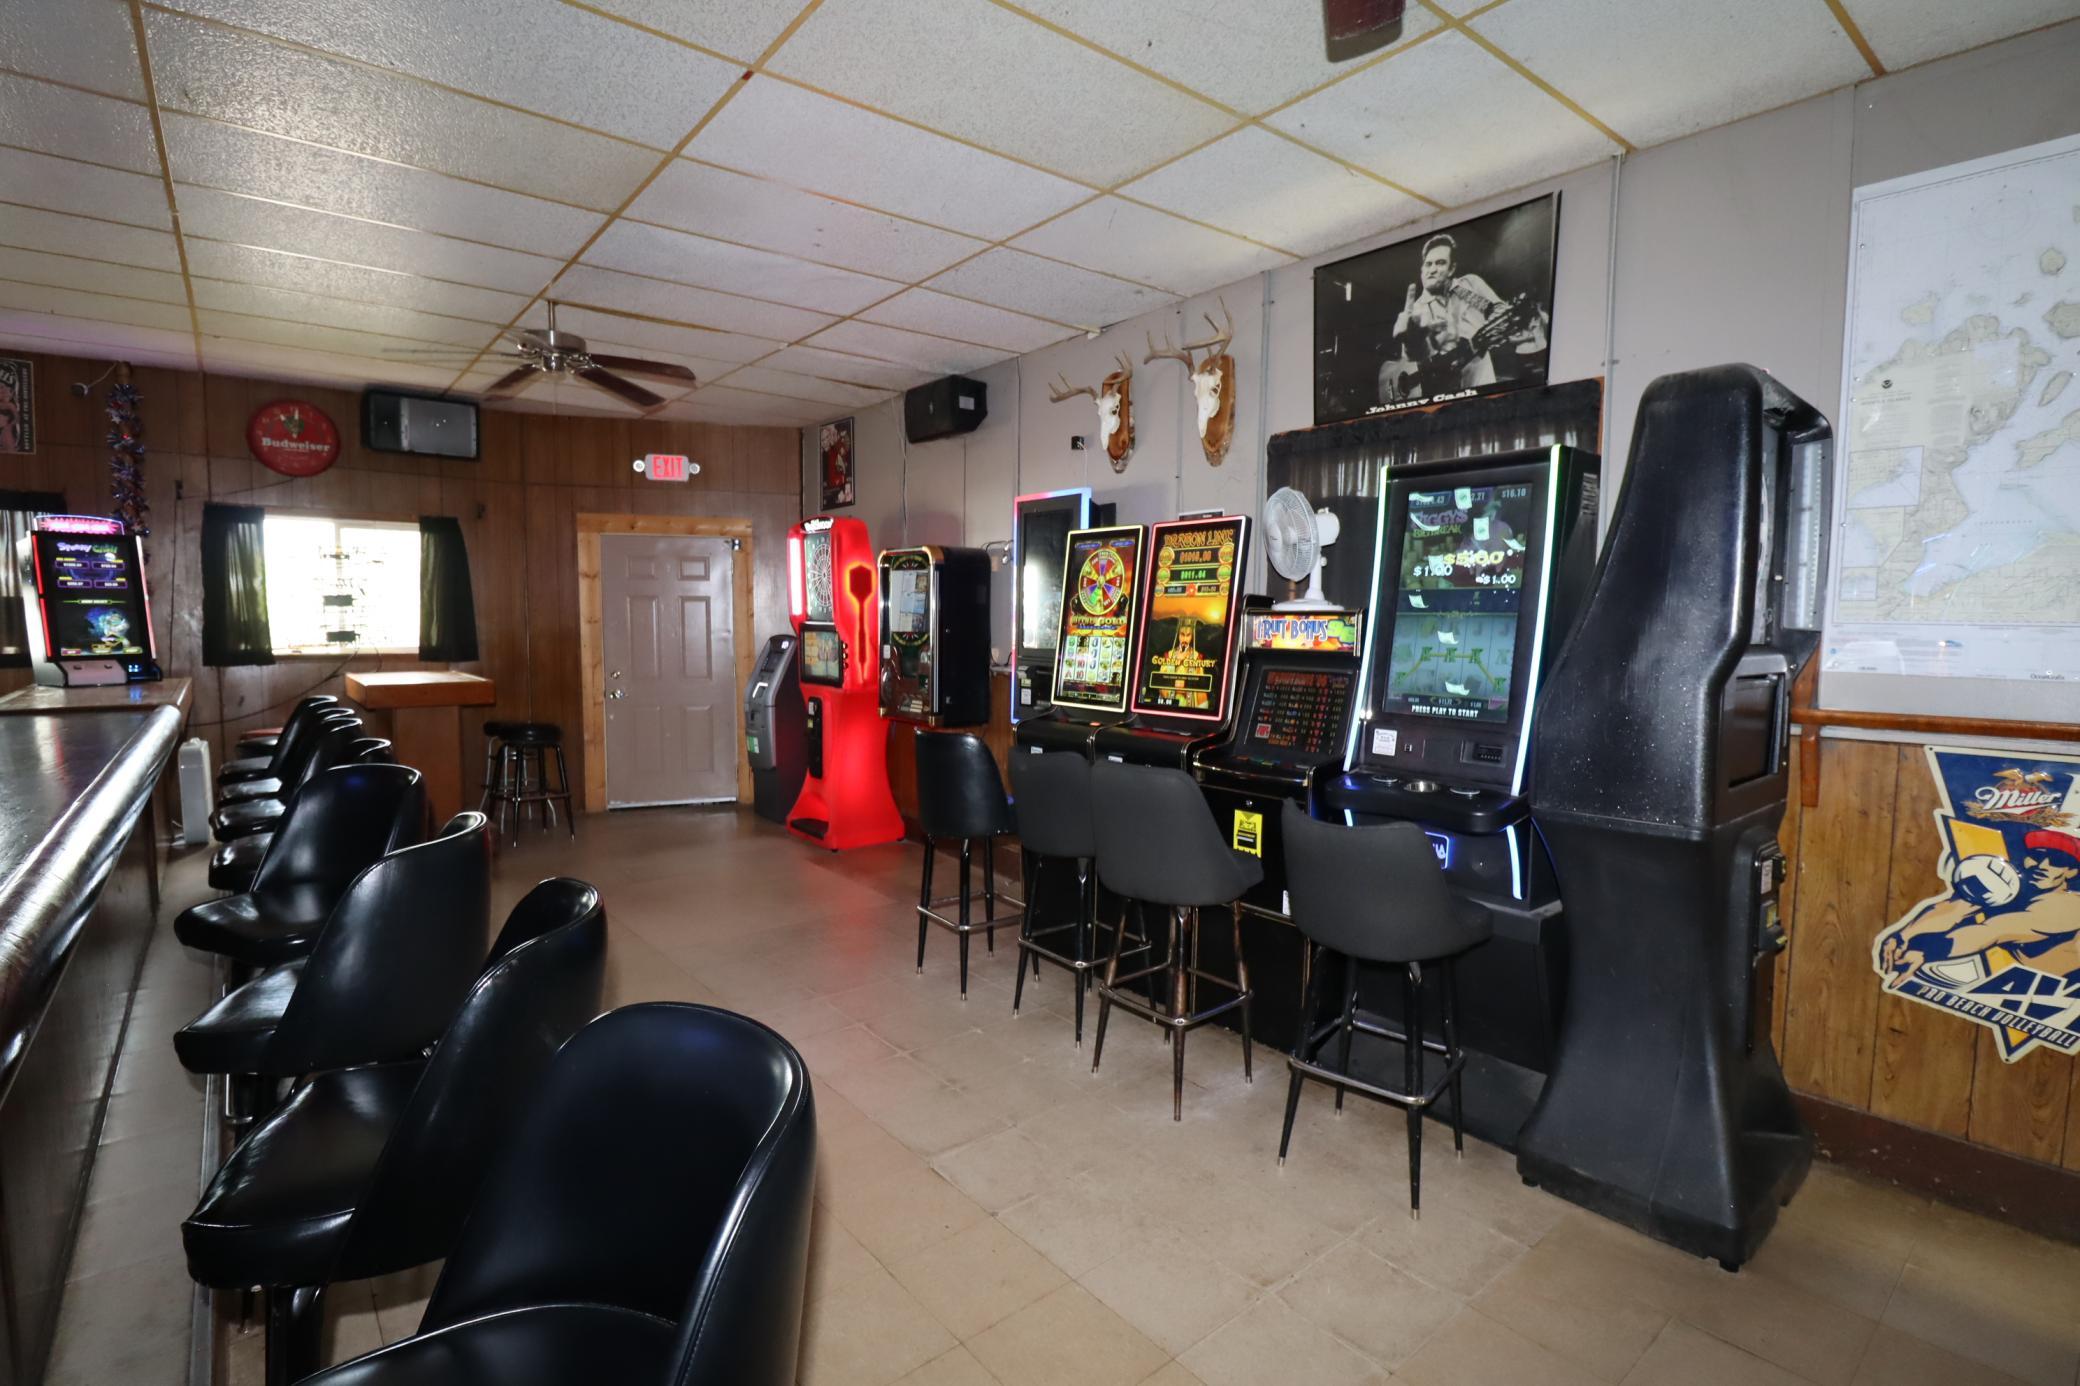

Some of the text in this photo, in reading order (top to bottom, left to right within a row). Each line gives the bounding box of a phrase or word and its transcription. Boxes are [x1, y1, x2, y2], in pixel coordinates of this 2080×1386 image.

[1365, 389, 1478, 415] Johnny Cash
[262, 437, 331, 452] Budweiser
[652, 456, 683, 478] EXIT
[1163, 528, 1234, 548] DRAGON LINK
[1290, 619, 1328, 641] BONUS
[1151, 655, 1216, 668] GOLDEN CENTURY
[1411, 705, 1479, 718] PRESS PLAY TO START
[1975, 786, 2062, 811] Miller
[1916, 986, 2077, 1048] PRO BEACH VOLLEYBALL
